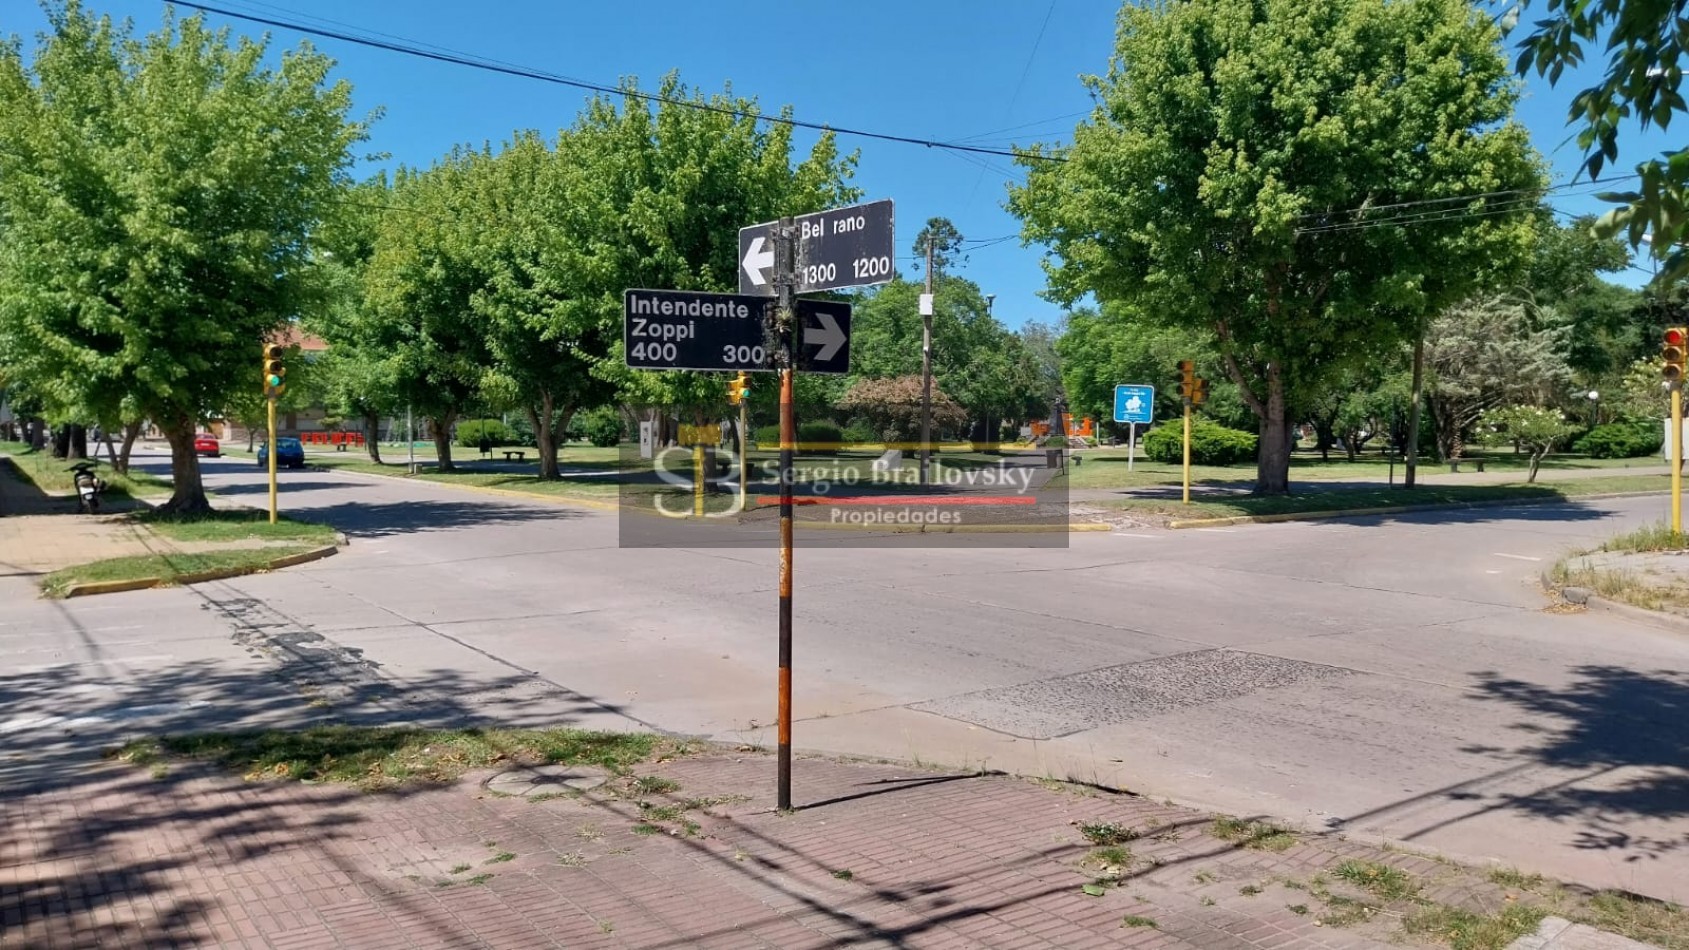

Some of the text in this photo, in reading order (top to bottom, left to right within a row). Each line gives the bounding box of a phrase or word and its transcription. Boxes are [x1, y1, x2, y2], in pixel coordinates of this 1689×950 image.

[803, 256, 890, 284] 1300 1200
[631, 294, 749, 318] Intendente
[631, 318, 695, 341] Zoppi
[631, 342, 765, 363] 400 300
